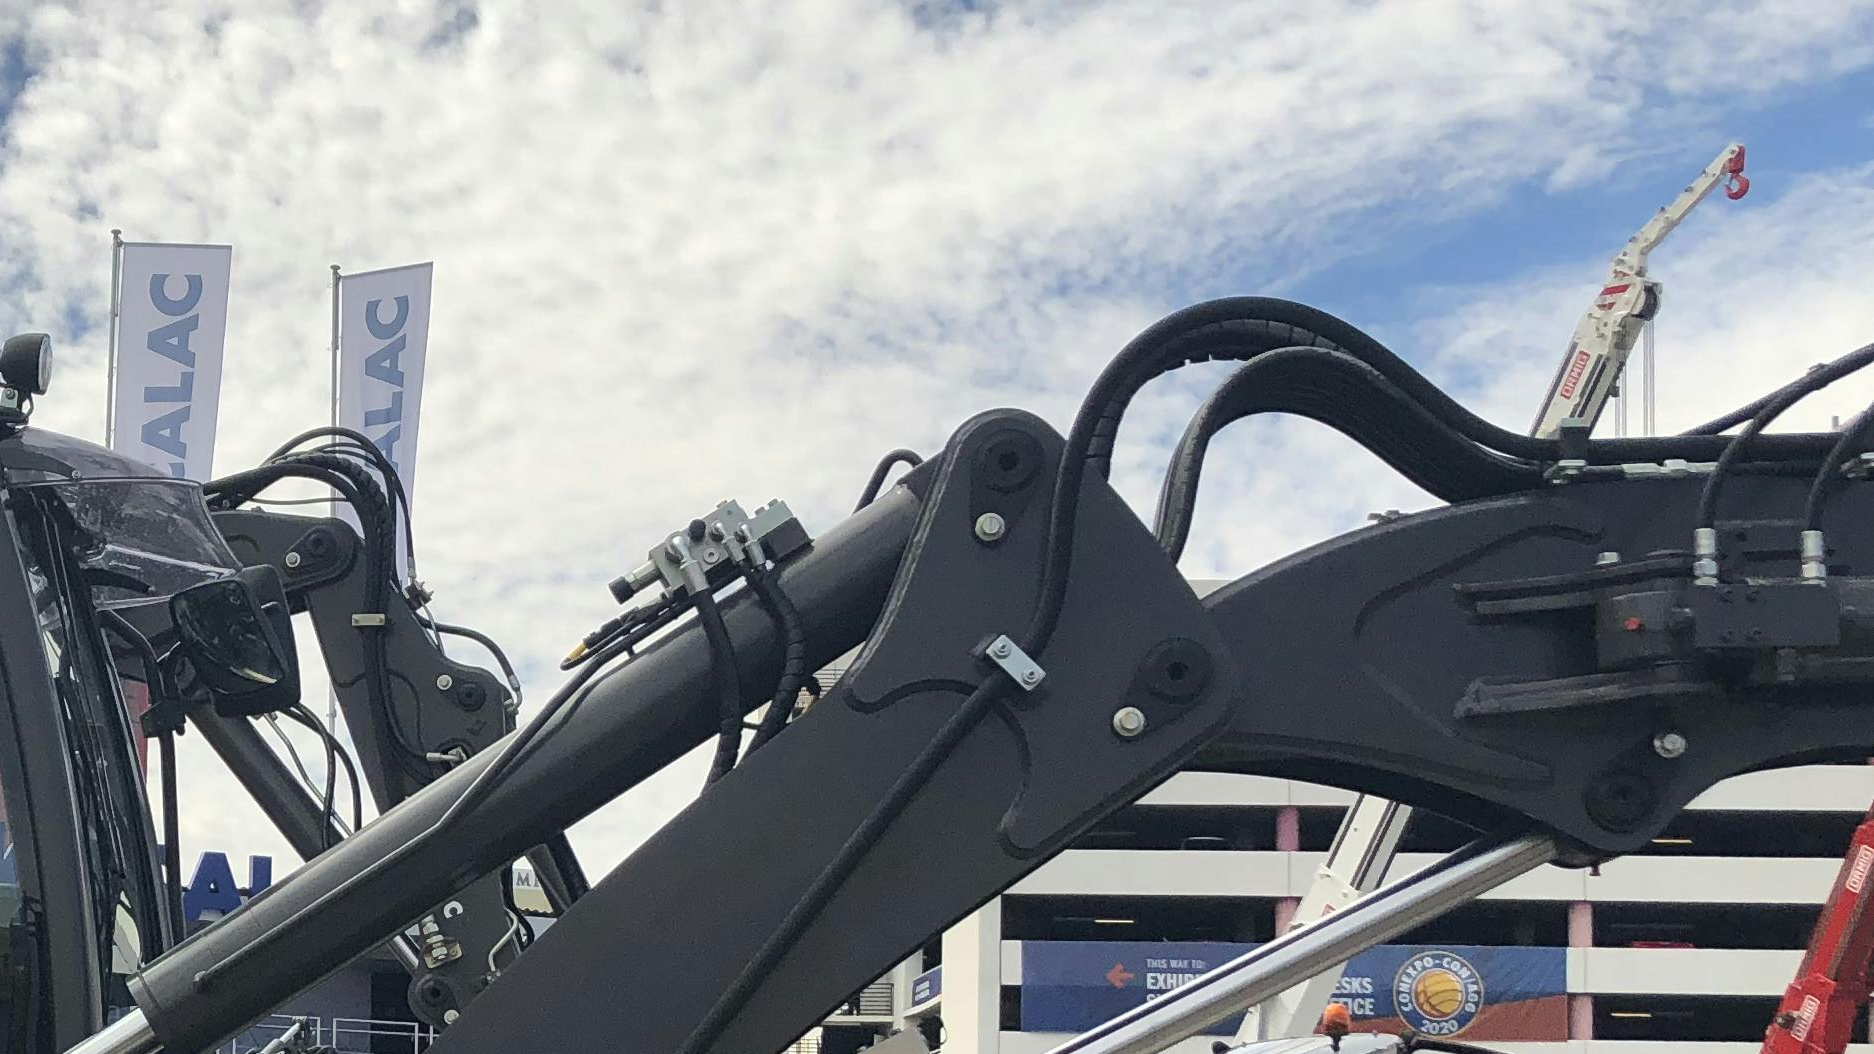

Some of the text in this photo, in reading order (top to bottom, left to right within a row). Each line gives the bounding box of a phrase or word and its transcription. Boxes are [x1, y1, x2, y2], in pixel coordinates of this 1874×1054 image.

[141, 273, 203, 478] ALAC
[1146, 959, 1167, 968] THIS
[1170, 960, 1189, 968] WAY
[1419, 1019, 1459, 1036] 2020
